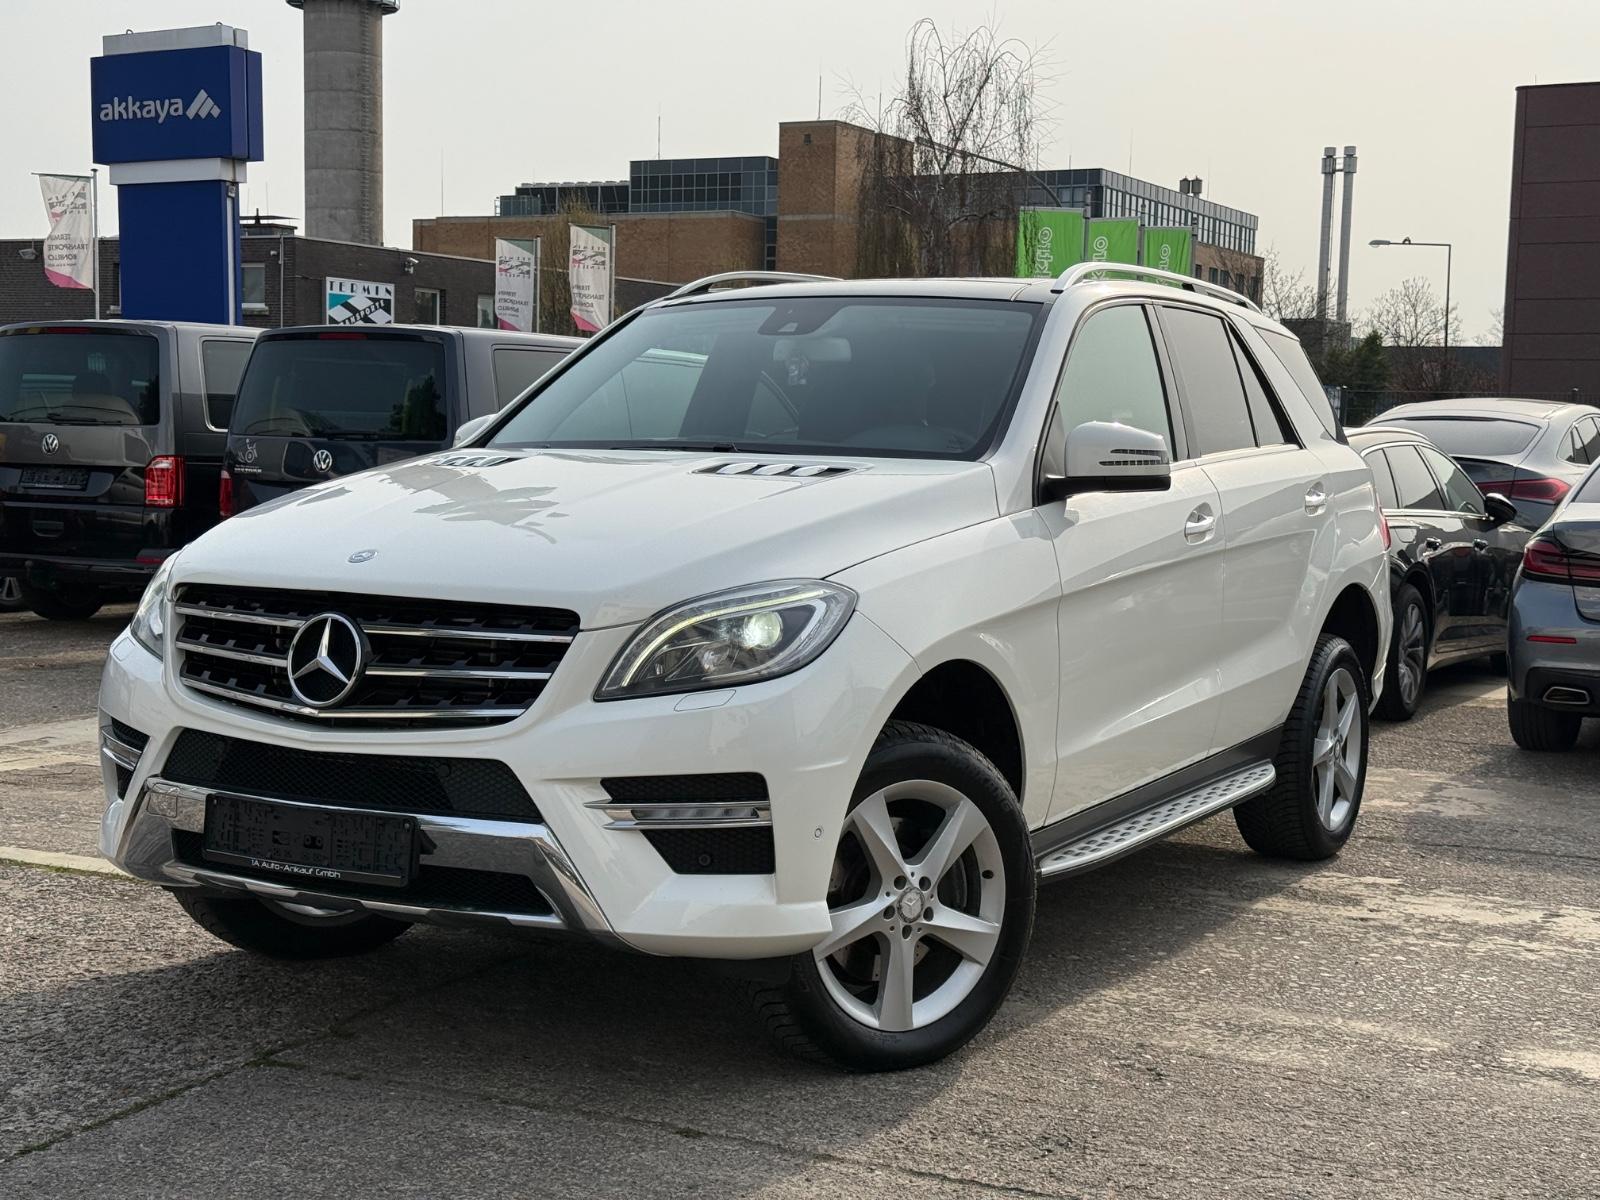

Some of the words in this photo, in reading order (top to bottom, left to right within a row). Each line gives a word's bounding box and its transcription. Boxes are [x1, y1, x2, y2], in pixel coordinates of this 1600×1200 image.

[99, 95, 184, 124] akkaya
[329, 281, 392, 296] TERMIN
[261, 861, 313, 875] Auto-Ankauf
